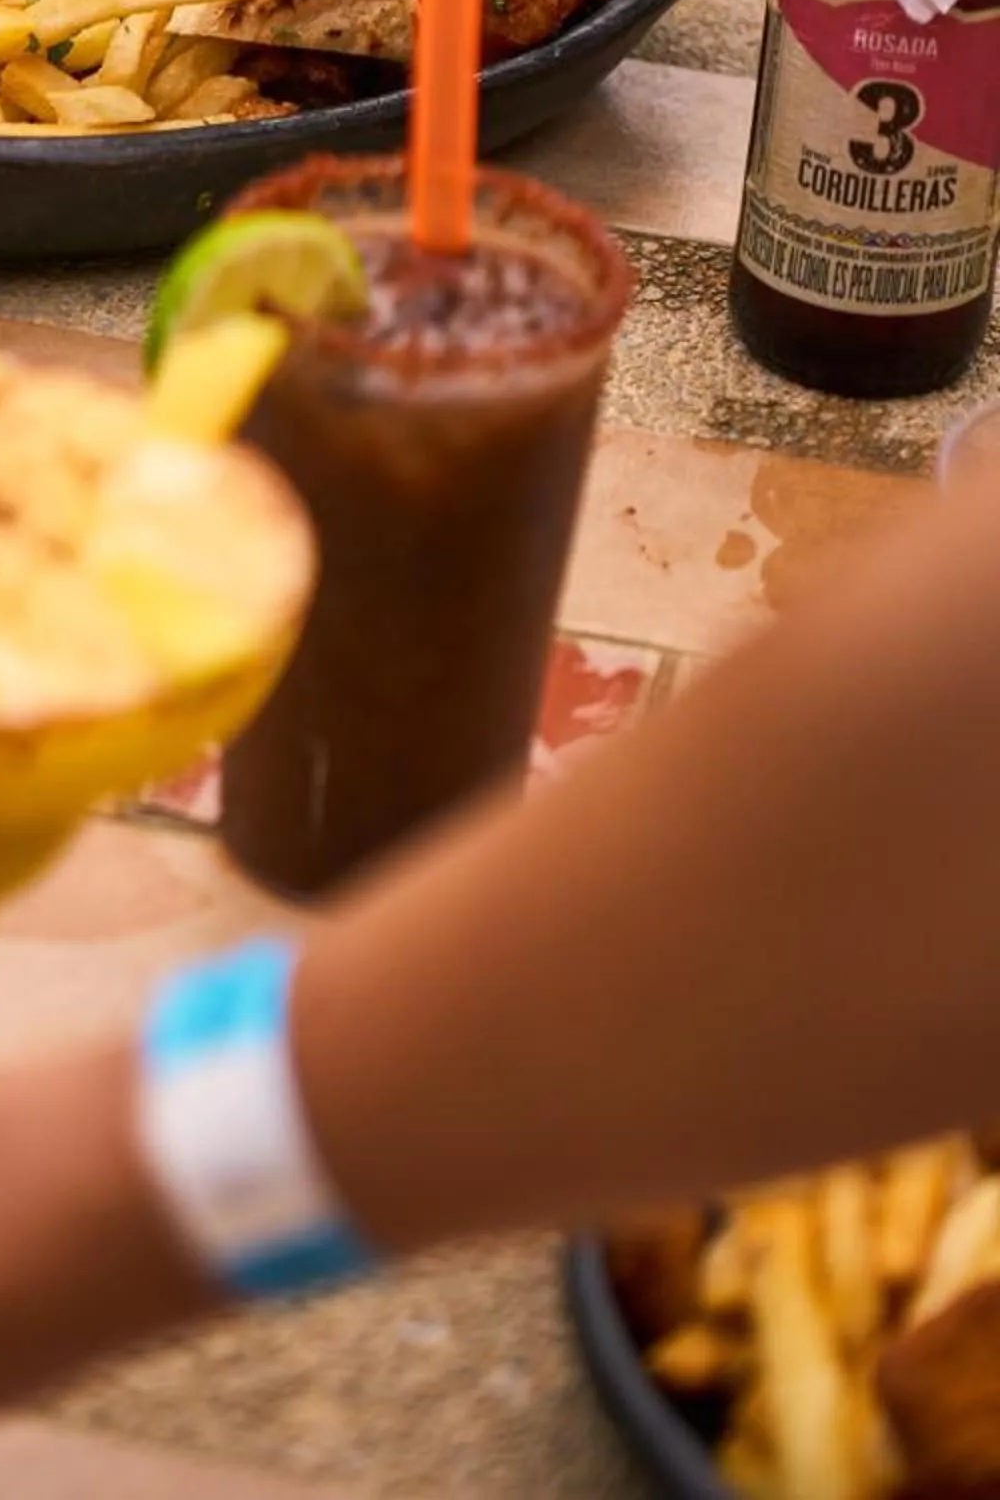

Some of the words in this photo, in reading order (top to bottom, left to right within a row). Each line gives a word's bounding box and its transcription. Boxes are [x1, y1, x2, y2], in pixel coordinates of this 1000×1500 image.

[853, 28, 938, 58] ROSADA
[849, 80, 921, 175] 3
[797, 158, 957, 212] CORDILLERAS
[833, 260, 849, 299] ES
